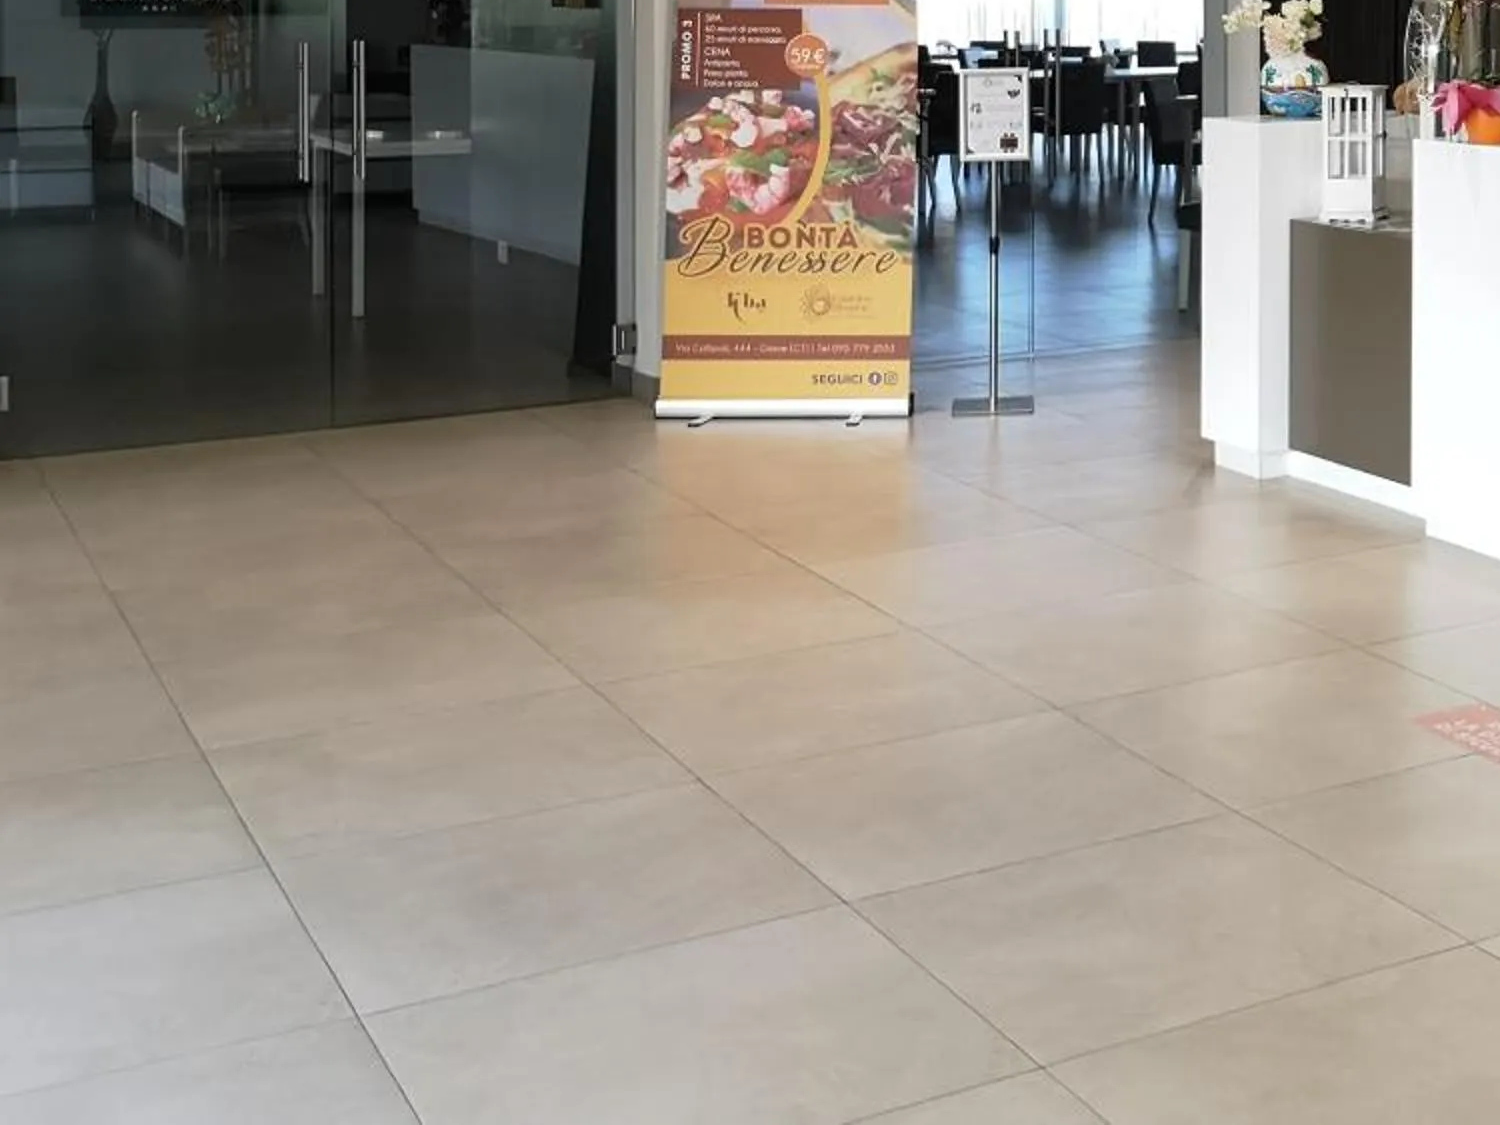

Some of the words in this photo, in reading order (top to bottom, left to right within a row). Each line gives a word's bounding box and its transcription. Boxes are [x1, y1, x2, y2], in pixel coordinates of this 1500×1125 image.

[682, 19, 693, 28] 3
[681, 31, 692, 80] PROMO
[678, 216, 897, 277] Benessere
